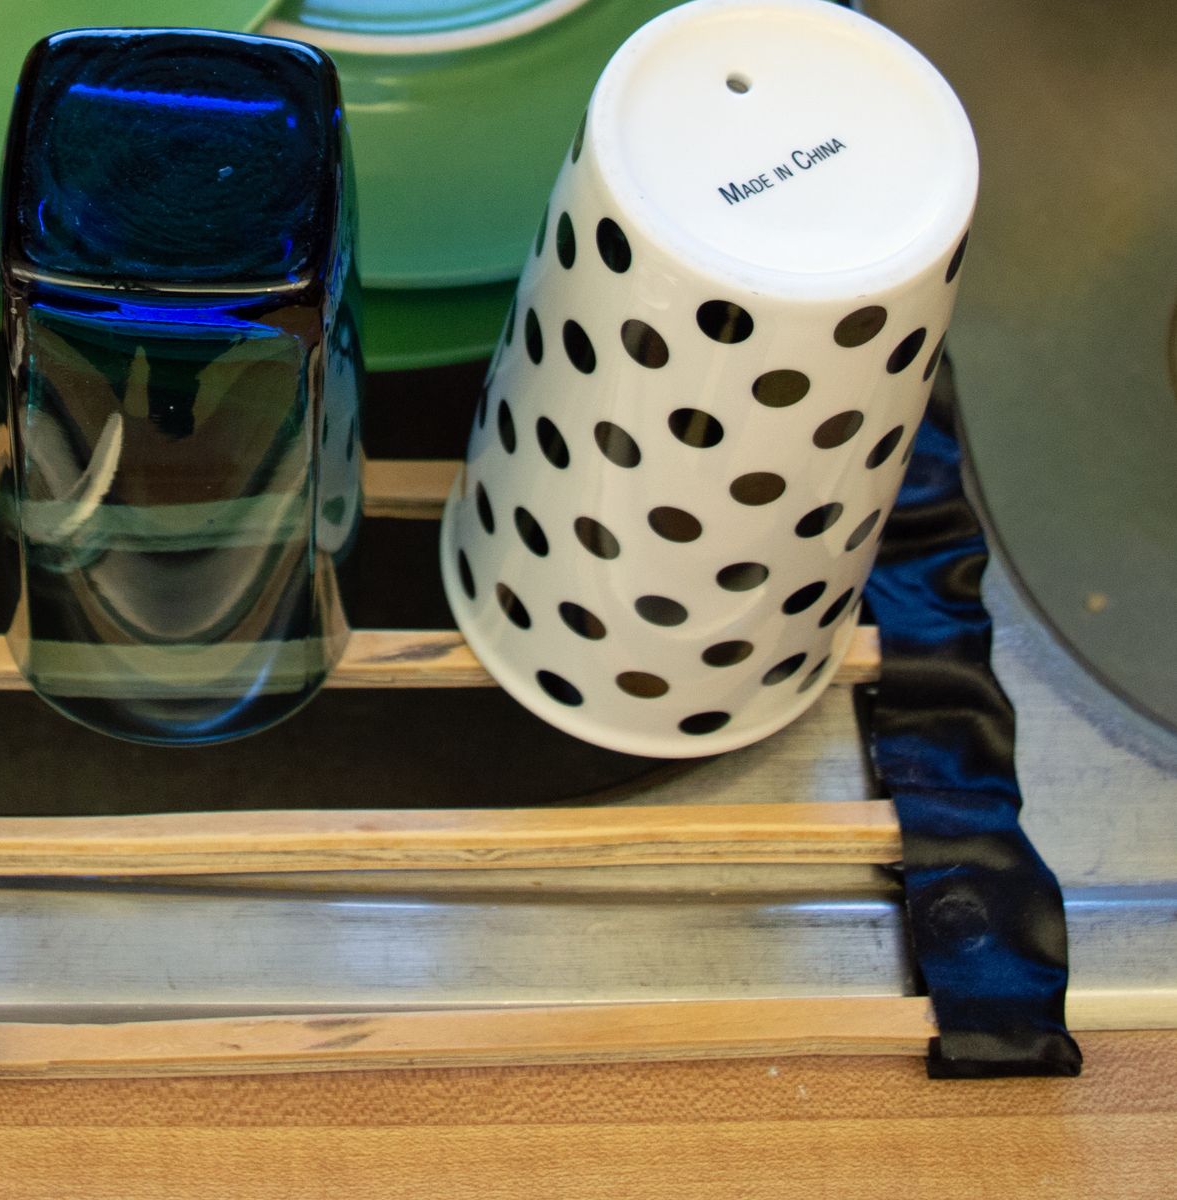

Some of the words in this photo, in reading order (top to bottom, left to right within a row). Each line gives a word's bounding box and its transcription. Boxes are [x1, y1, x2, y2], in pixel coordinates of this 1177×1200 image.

[718, 173, 774, 205] MADE
[773, 164, 794, 181] IN
[791, 138, 846, 170] CHINA
